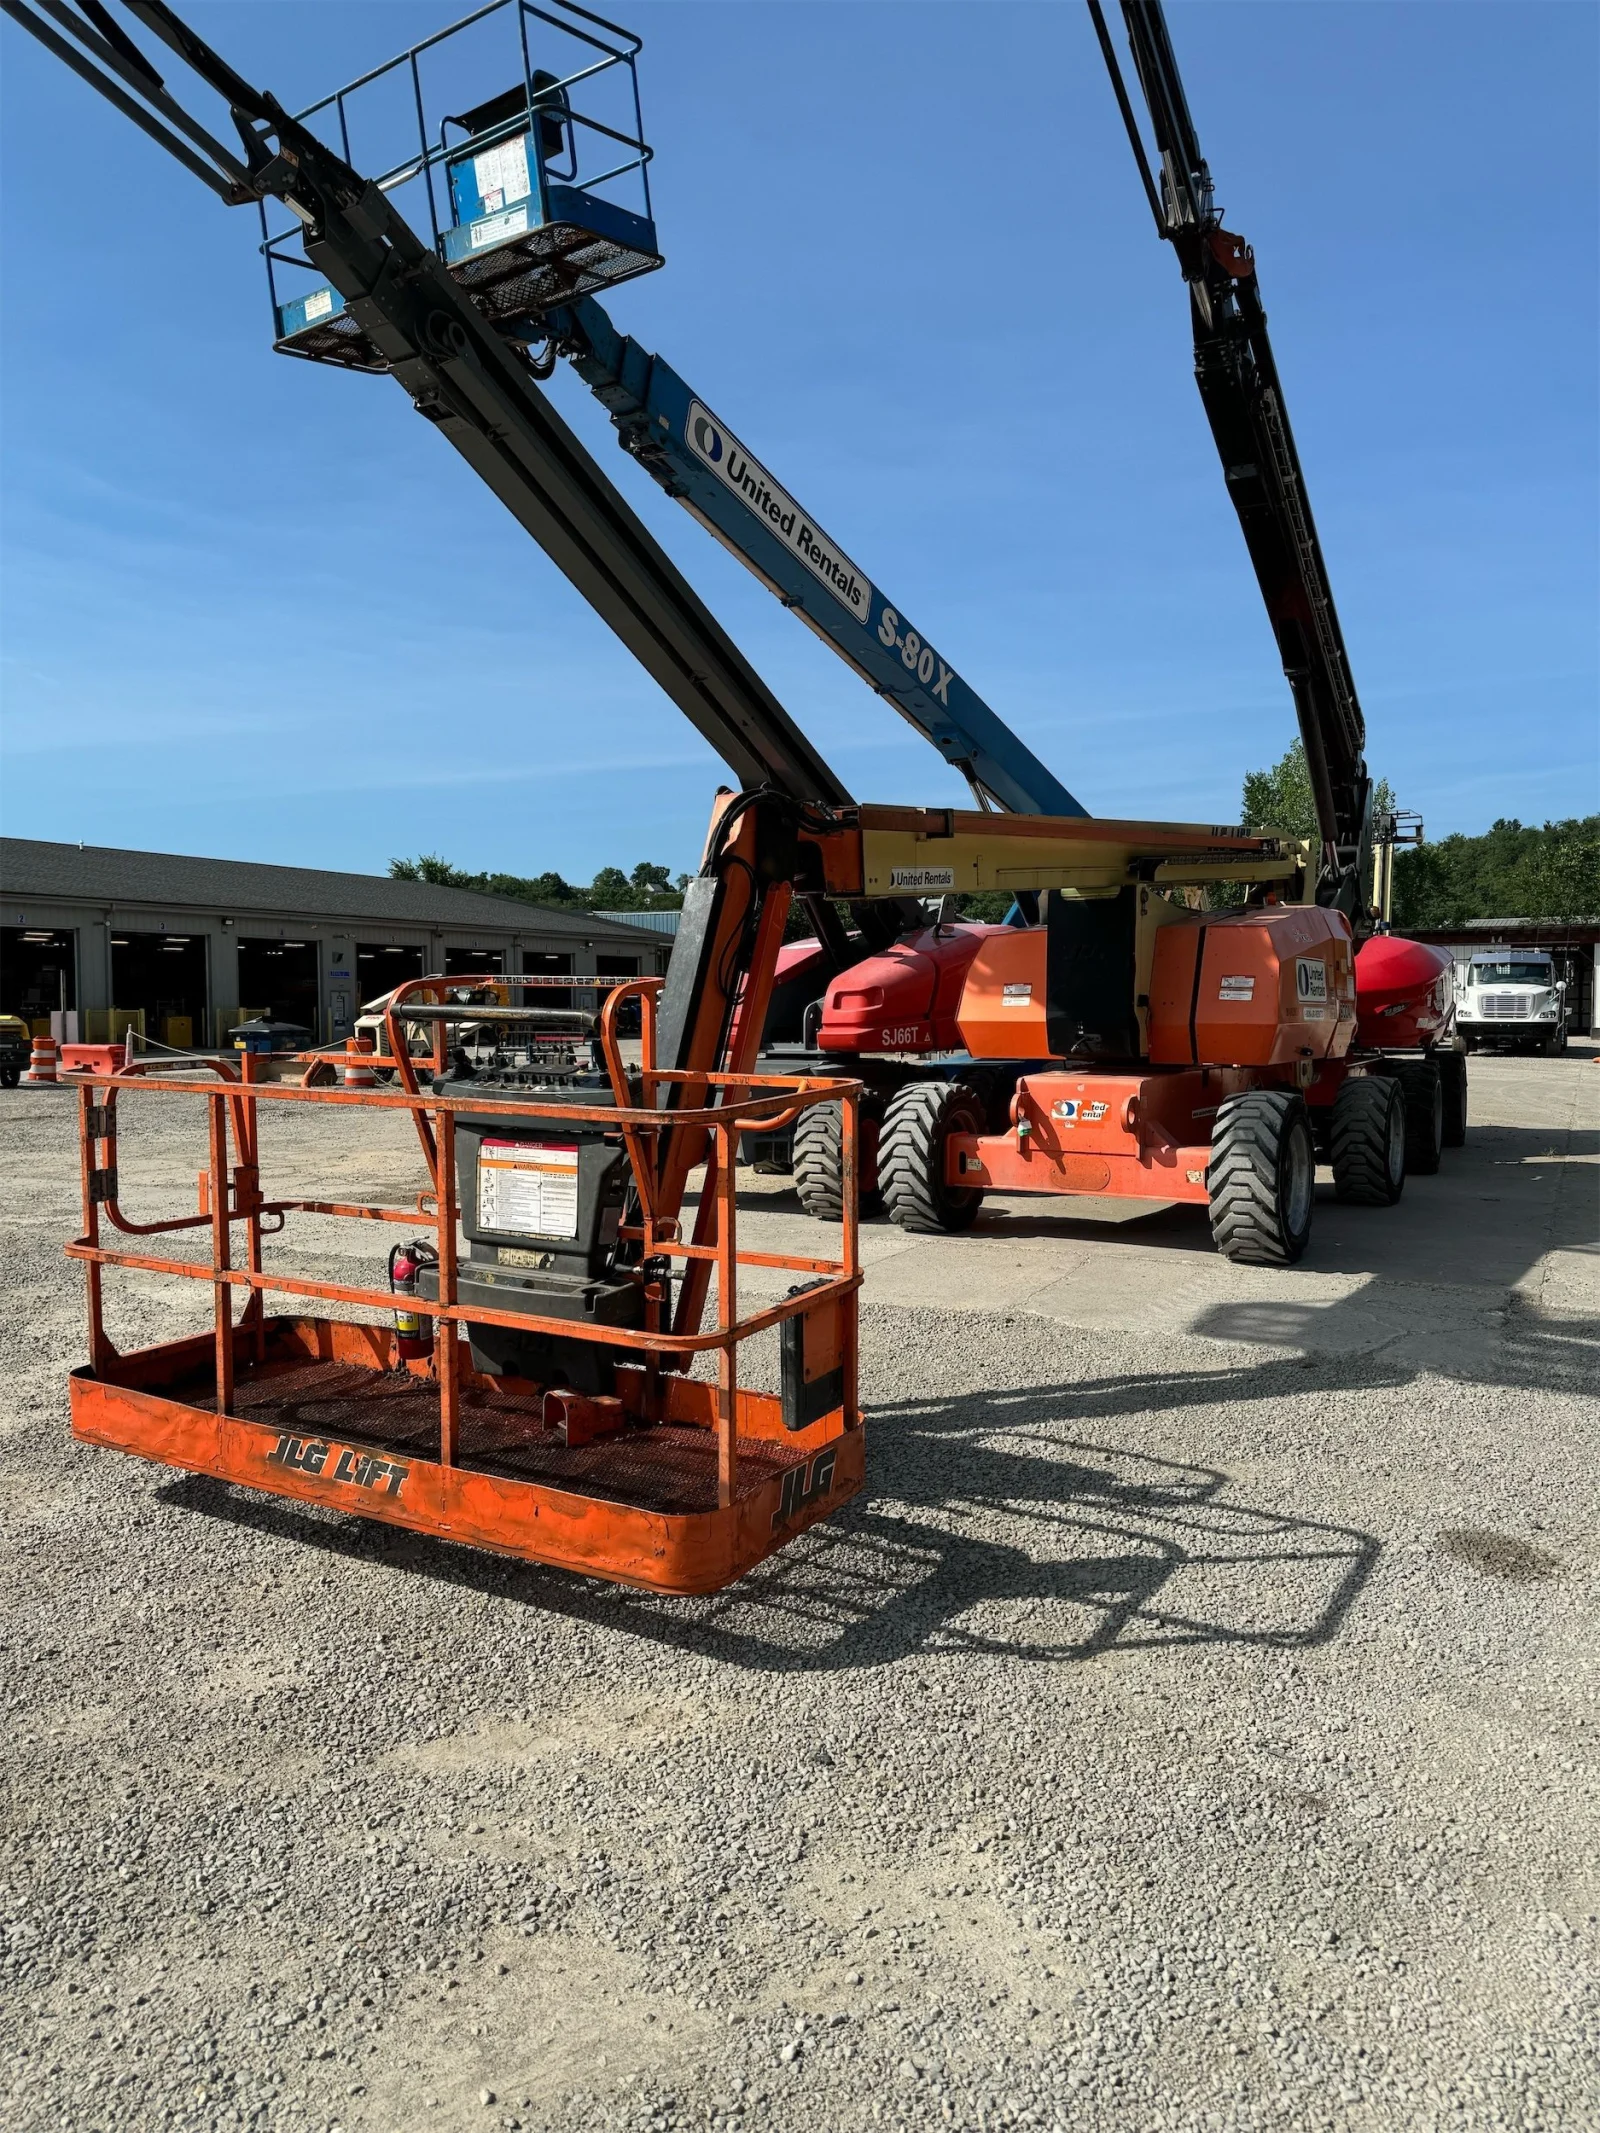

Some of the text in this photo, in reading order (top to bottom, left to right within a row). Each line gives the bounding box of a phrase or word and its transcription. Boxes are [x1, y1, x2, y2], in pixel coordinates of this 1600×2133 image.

[727, 449, 863, 607] United Rentals
[877, 607, 955, 707] S-80X
[896, 870, 952, 886] United Rentals
[1308, 965, 1324, 981] United
[1310, 981, 1326, 997] Rentals
[881, 1026, 919, 1046] SJ66T
[519, 1141, 543, 1149] DANGER
[265, 1435, 411, 1498] JLG LIFT
[769, 1446, 838, 1535] JLG
